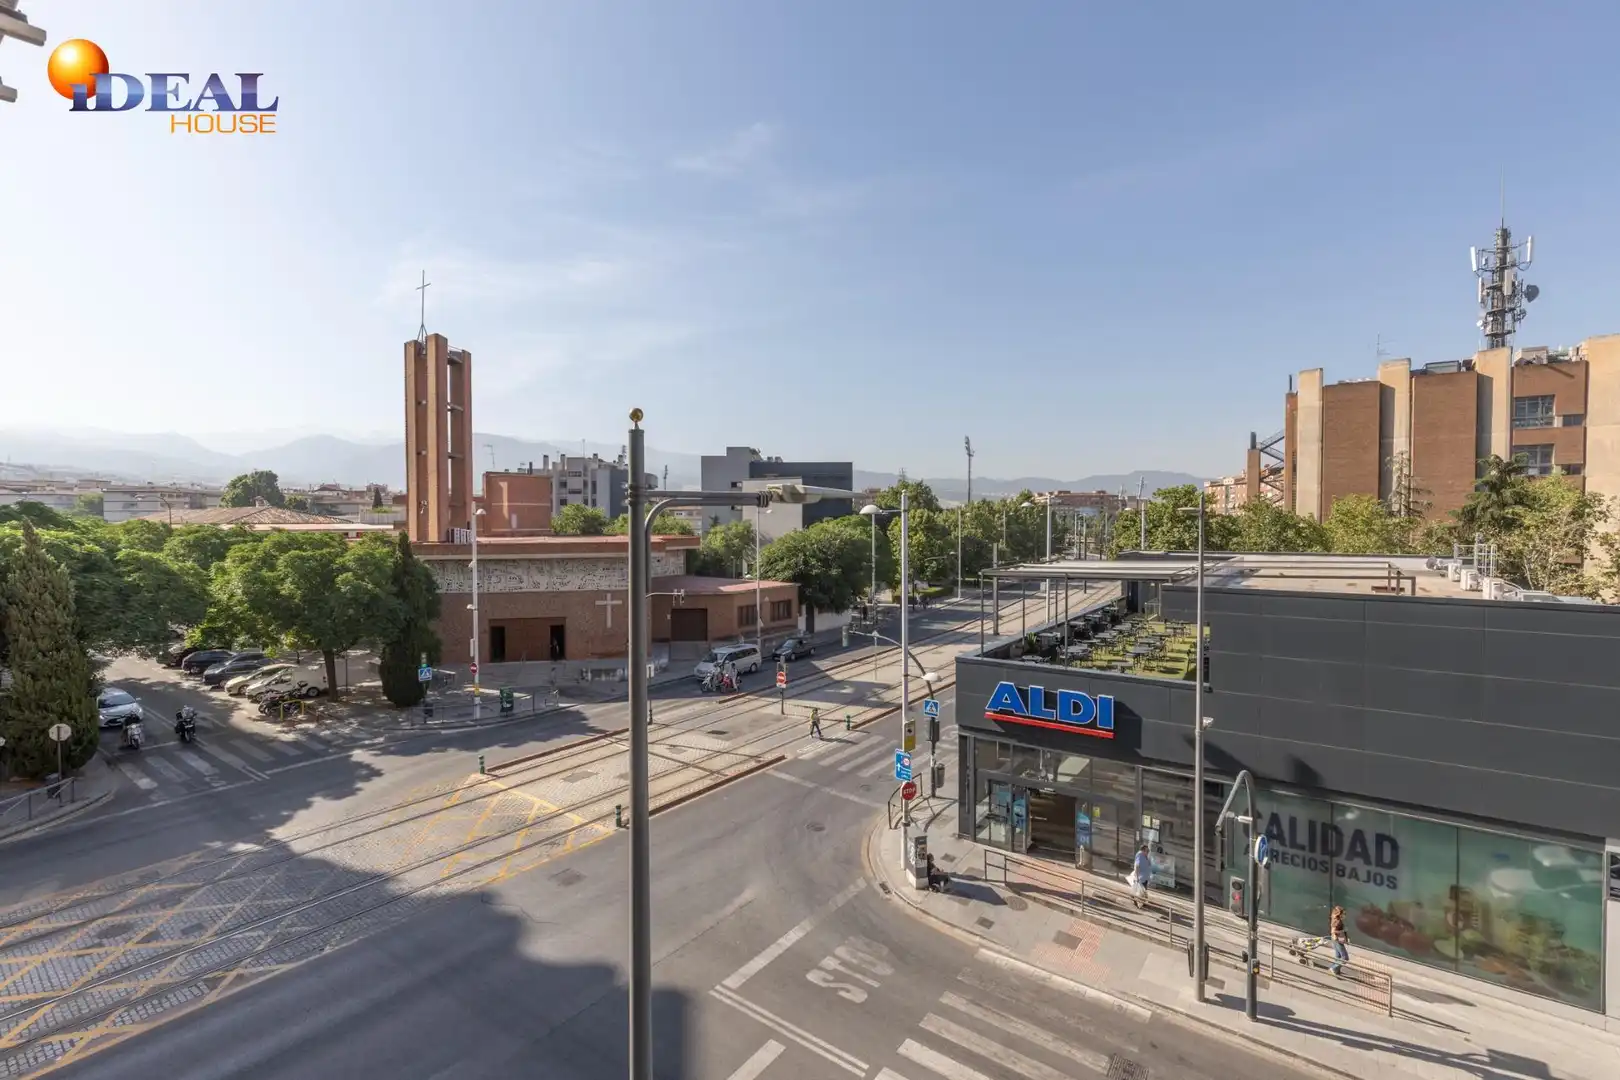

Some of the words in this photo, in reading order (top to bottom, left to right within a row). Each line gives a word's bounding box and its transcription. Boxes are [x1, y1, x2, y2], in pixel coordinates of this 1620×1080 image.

[986, 681, 1115, 729] ALDI
[903, 787, 916, 795] STOP
[1264, 847, 1329, 874] RECIOS
[1335, 863, 1398, 890] BAJOS
